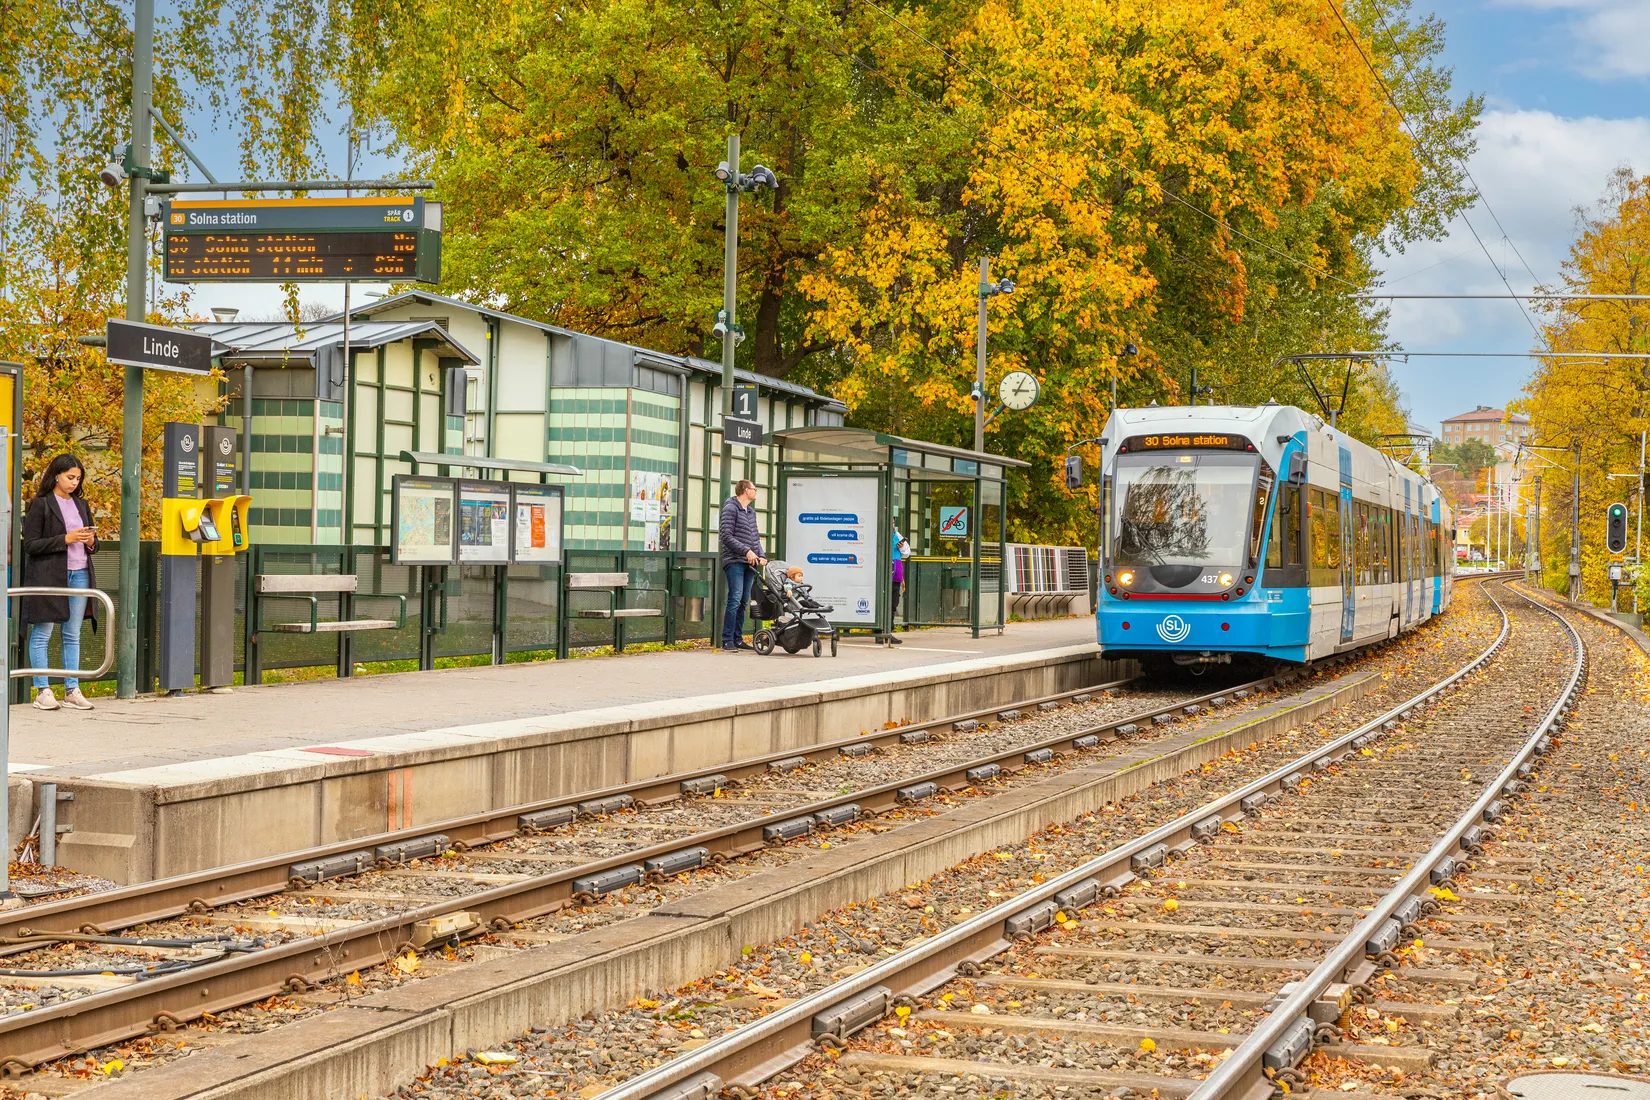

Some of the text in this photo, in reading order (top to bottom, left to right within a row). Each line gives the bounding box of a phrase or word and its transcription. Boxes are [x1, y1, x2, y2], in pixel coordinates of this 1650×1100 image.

[173, 212, 257, 225] 30 Solna station
[143, 336, 179, 358] Linde
[740, 393, 751, 415] 1
[737, 426, 752, 439] Linde
[1145, 435, 1228, 446] 30 Solna station
[1201, 575, 1218, 584] 437
[1166, 620, 1181, 631] SL
